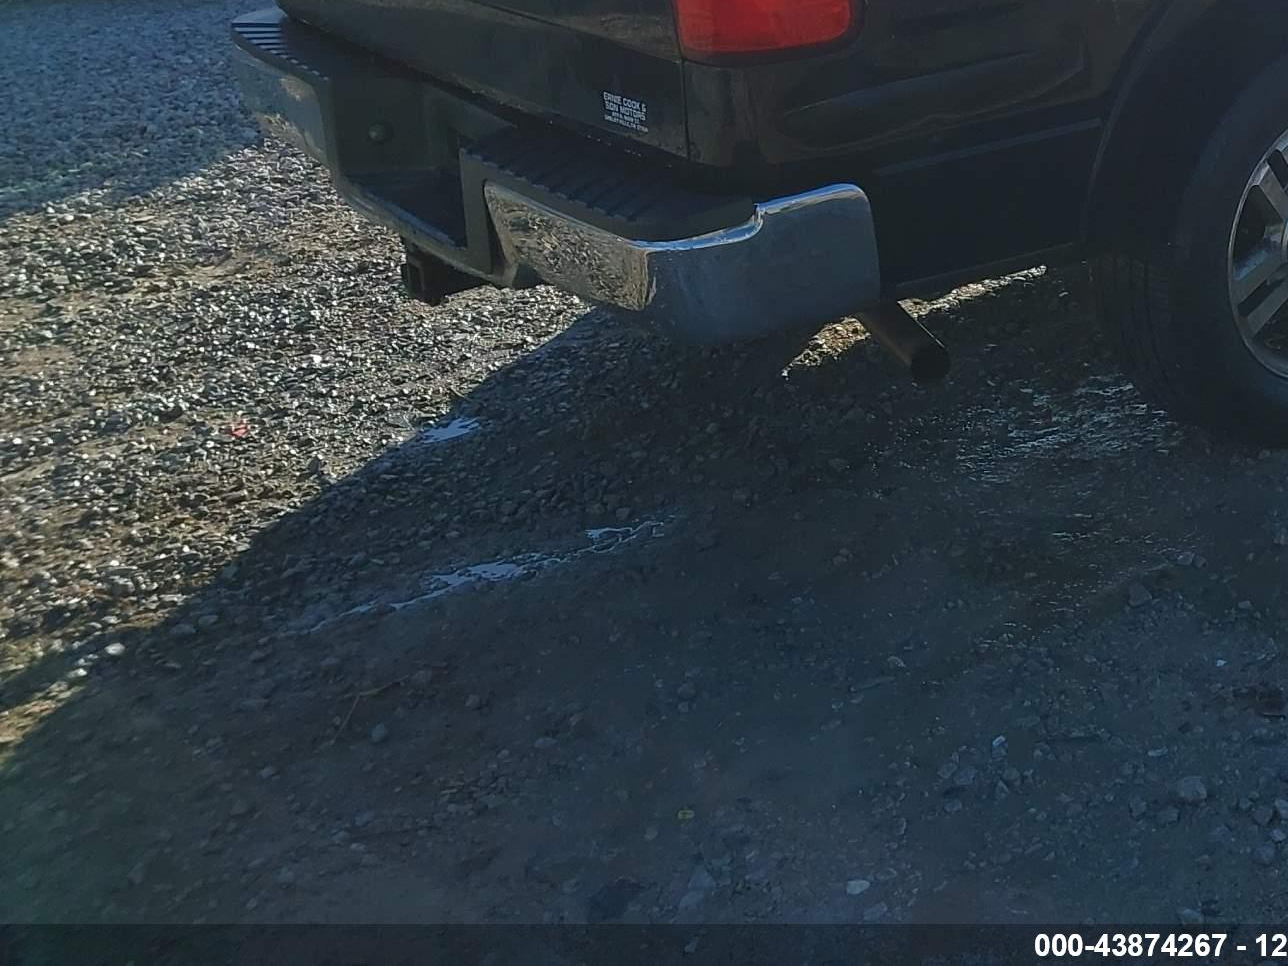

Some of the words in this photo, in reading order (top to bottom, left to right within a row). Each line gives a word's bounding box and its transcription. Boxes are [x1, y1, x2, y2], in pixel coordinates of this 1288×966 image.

[605, 100, 619, 112] SON
[619, 105, 646, 121] MOTORS
[622, 98, 641, 111] COOK
